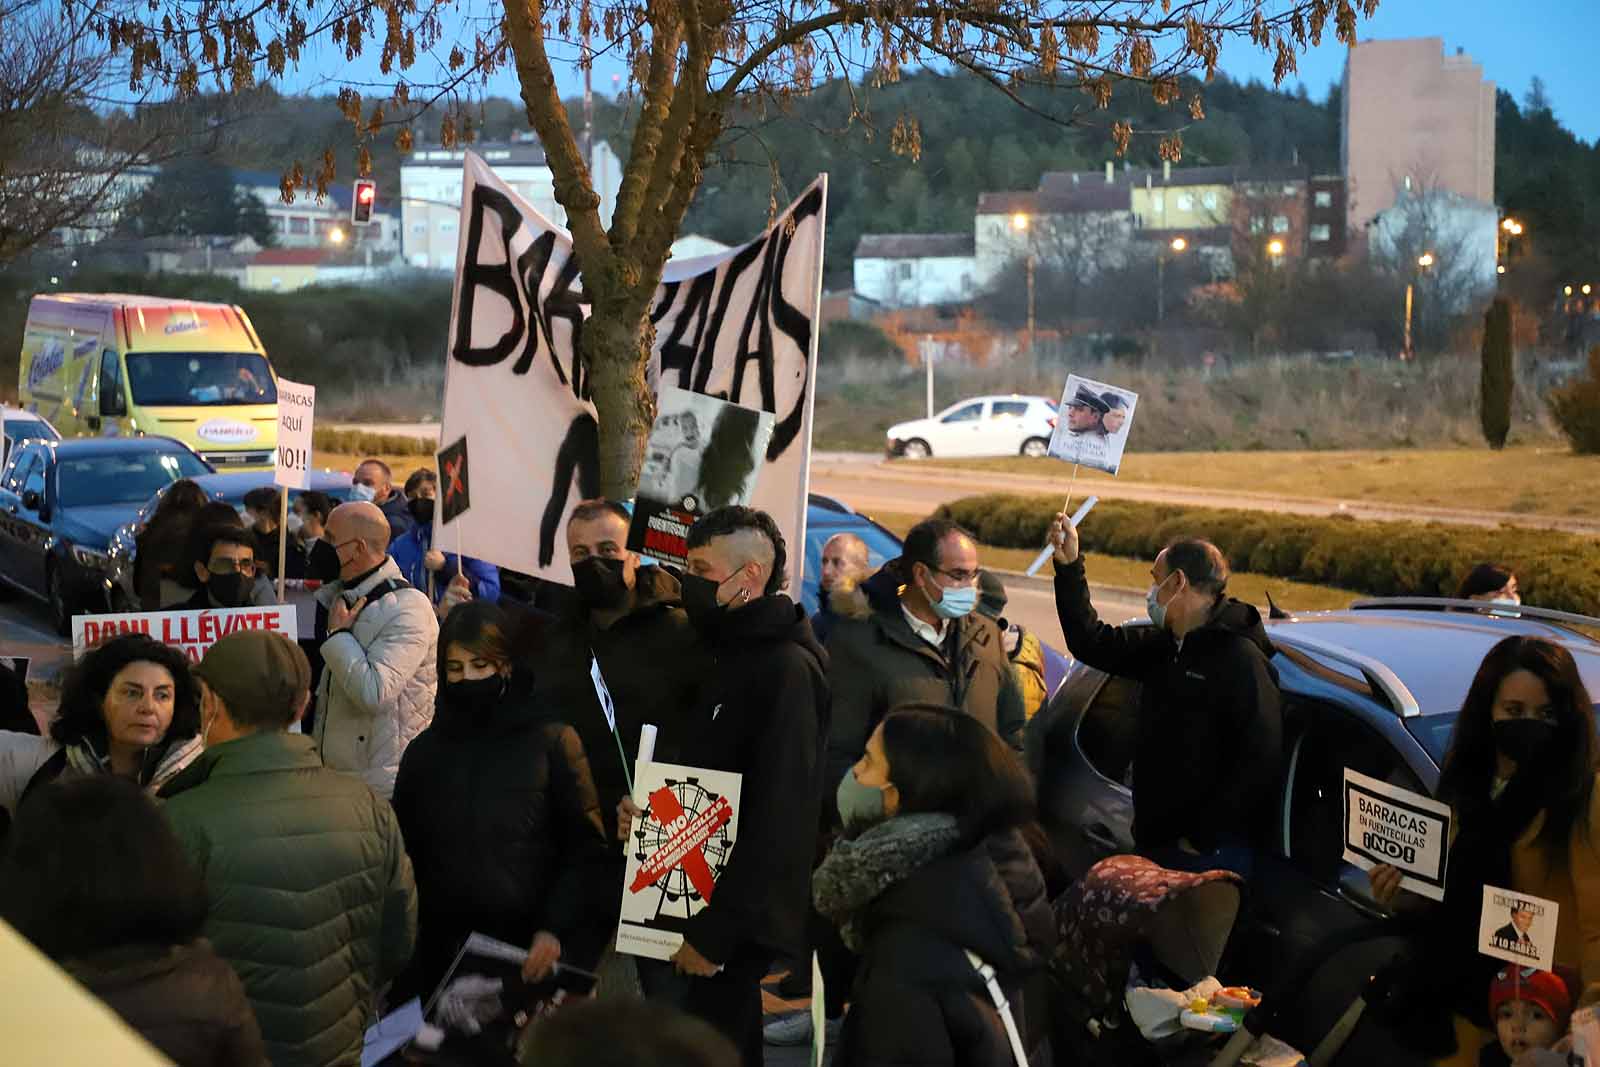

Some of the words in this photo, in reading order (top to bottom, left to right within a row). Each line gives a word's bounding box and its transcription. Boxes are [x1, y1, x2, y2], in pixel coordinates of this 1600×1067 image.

[278, 445, 307, 471] NO!!
[1359, 798, 1428, 835] BARRACAS
[1360, 814, 1369, 826] EN
[1368, 821, 1425, 848] FUENTECILLAS
[1363, 832, 1416, 864] ¡NO!
